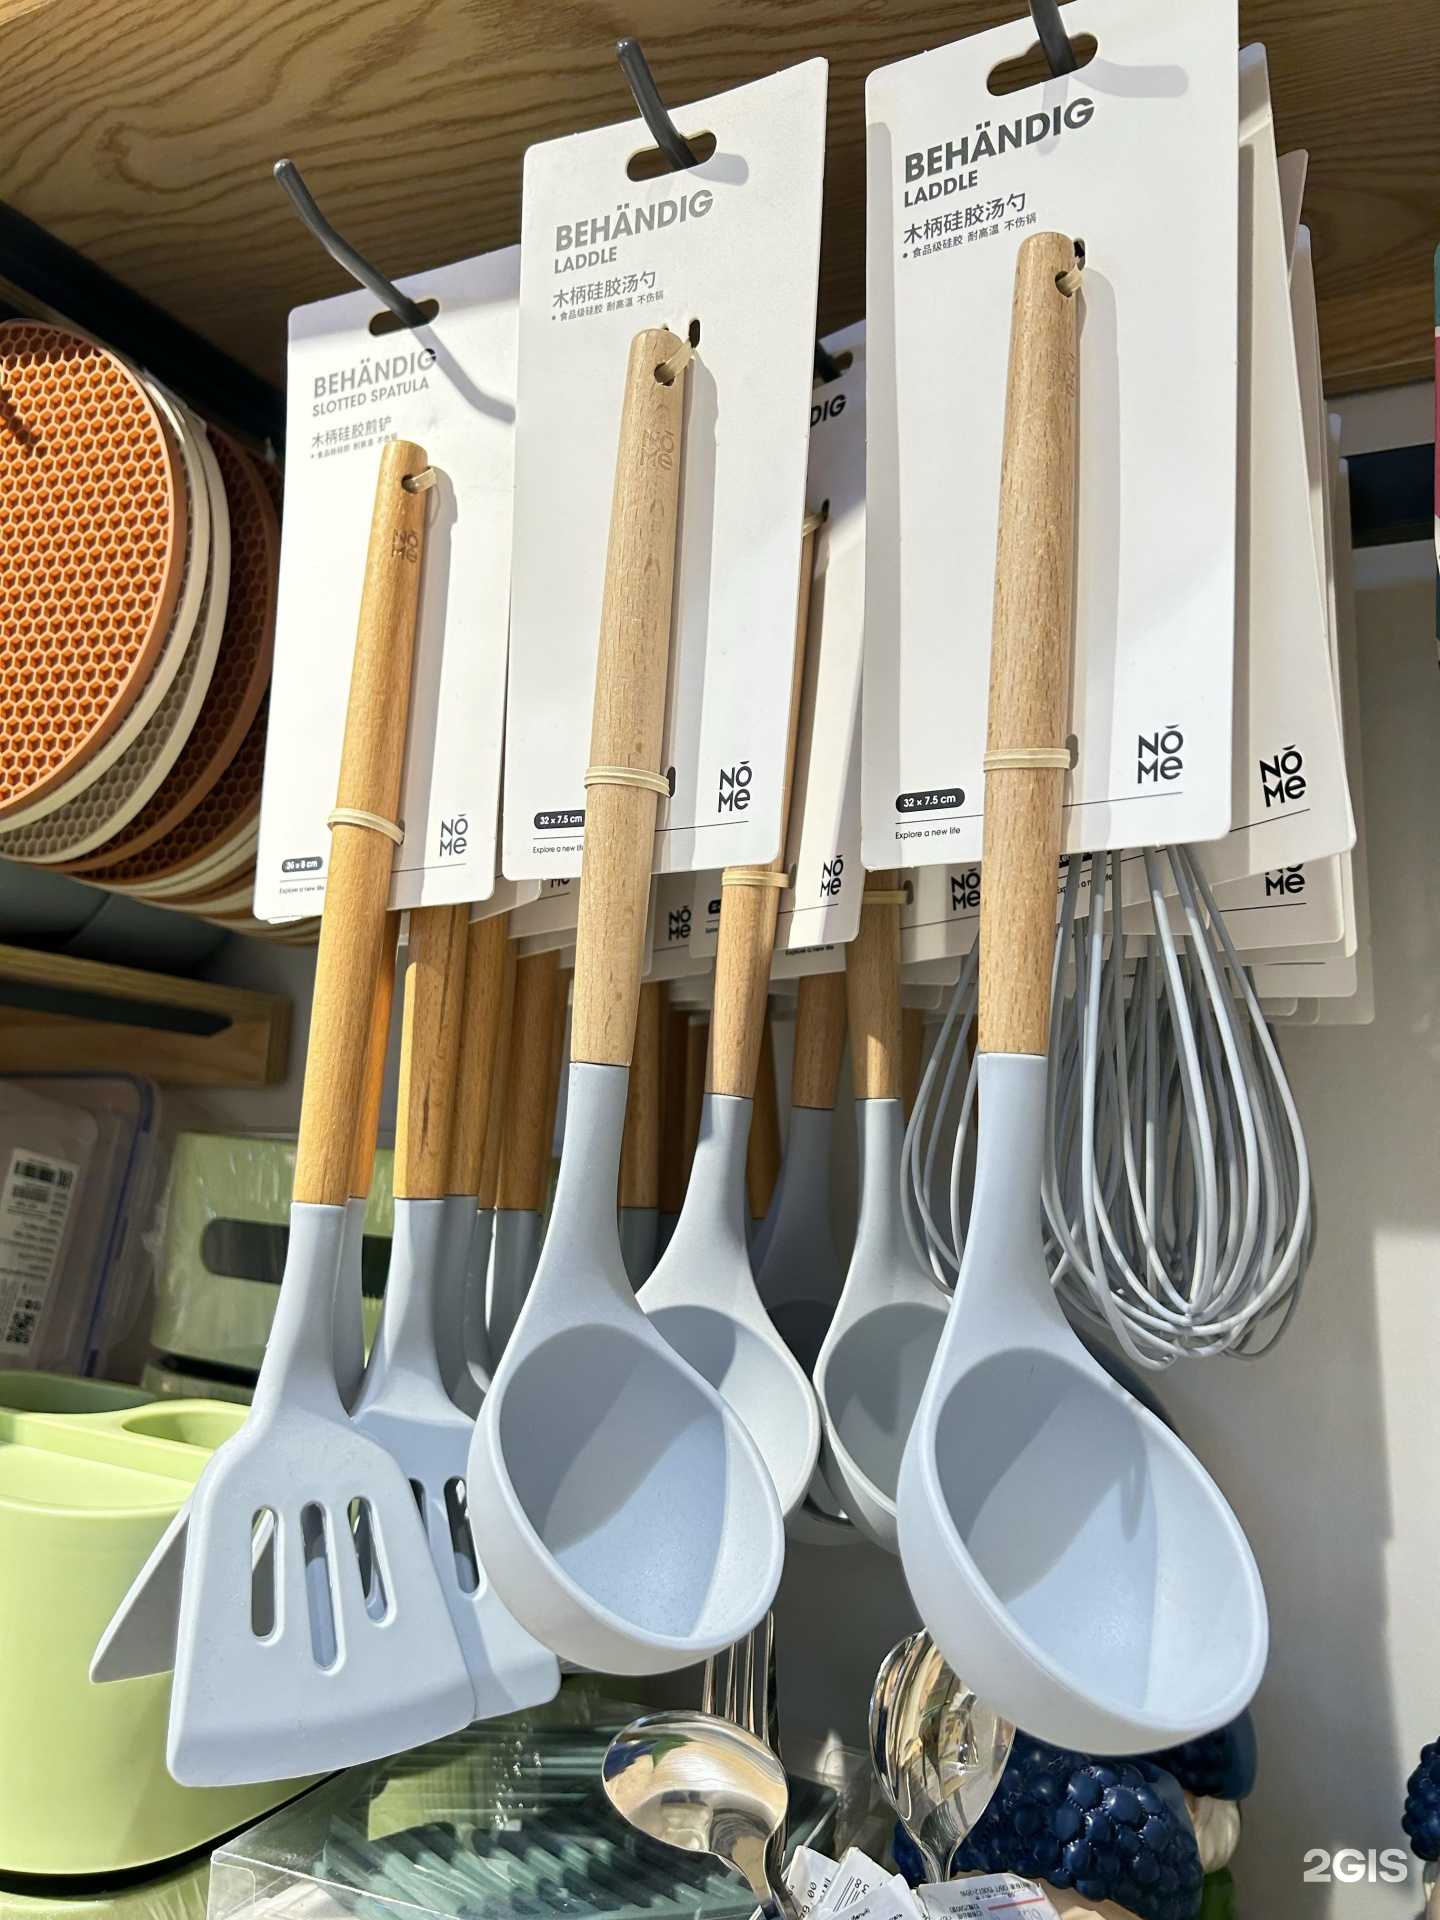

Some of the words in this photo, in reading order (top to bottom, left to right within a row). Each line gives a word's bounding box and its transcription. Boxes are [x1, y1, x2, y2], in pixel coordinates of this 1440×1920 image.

[905, 97, 1095, 183] BEHÄNDIG
[904, 170, 978, 208] LADDLE
[555, 189, 713, 252] BEHÄNDIG
[903, 192, 1026, 244] 木柄硅胶汤勺
[554, 246, 617, 274] LADDLE
[552, 271, 656, 308] 木柄硅胶汤勺
[313, 348, 437, 398] BEHÄNDIG
[312, 392, 367, 417] SLOTTED
[371, 377, 429, 402] SPATULA
[540, 816, 549, 825] 32
[557, 814, 569, 824] 7.5
[569, 815, 583, 823] cm
[903, 797, 914, 808] 32
[924, 795, 938, 805] 7.5
[940, 795, 956, 804] cm
[895, 830, 922, 840] Explore
[931, 828, 948, 836] new
[949, 826, 961, 834] life
